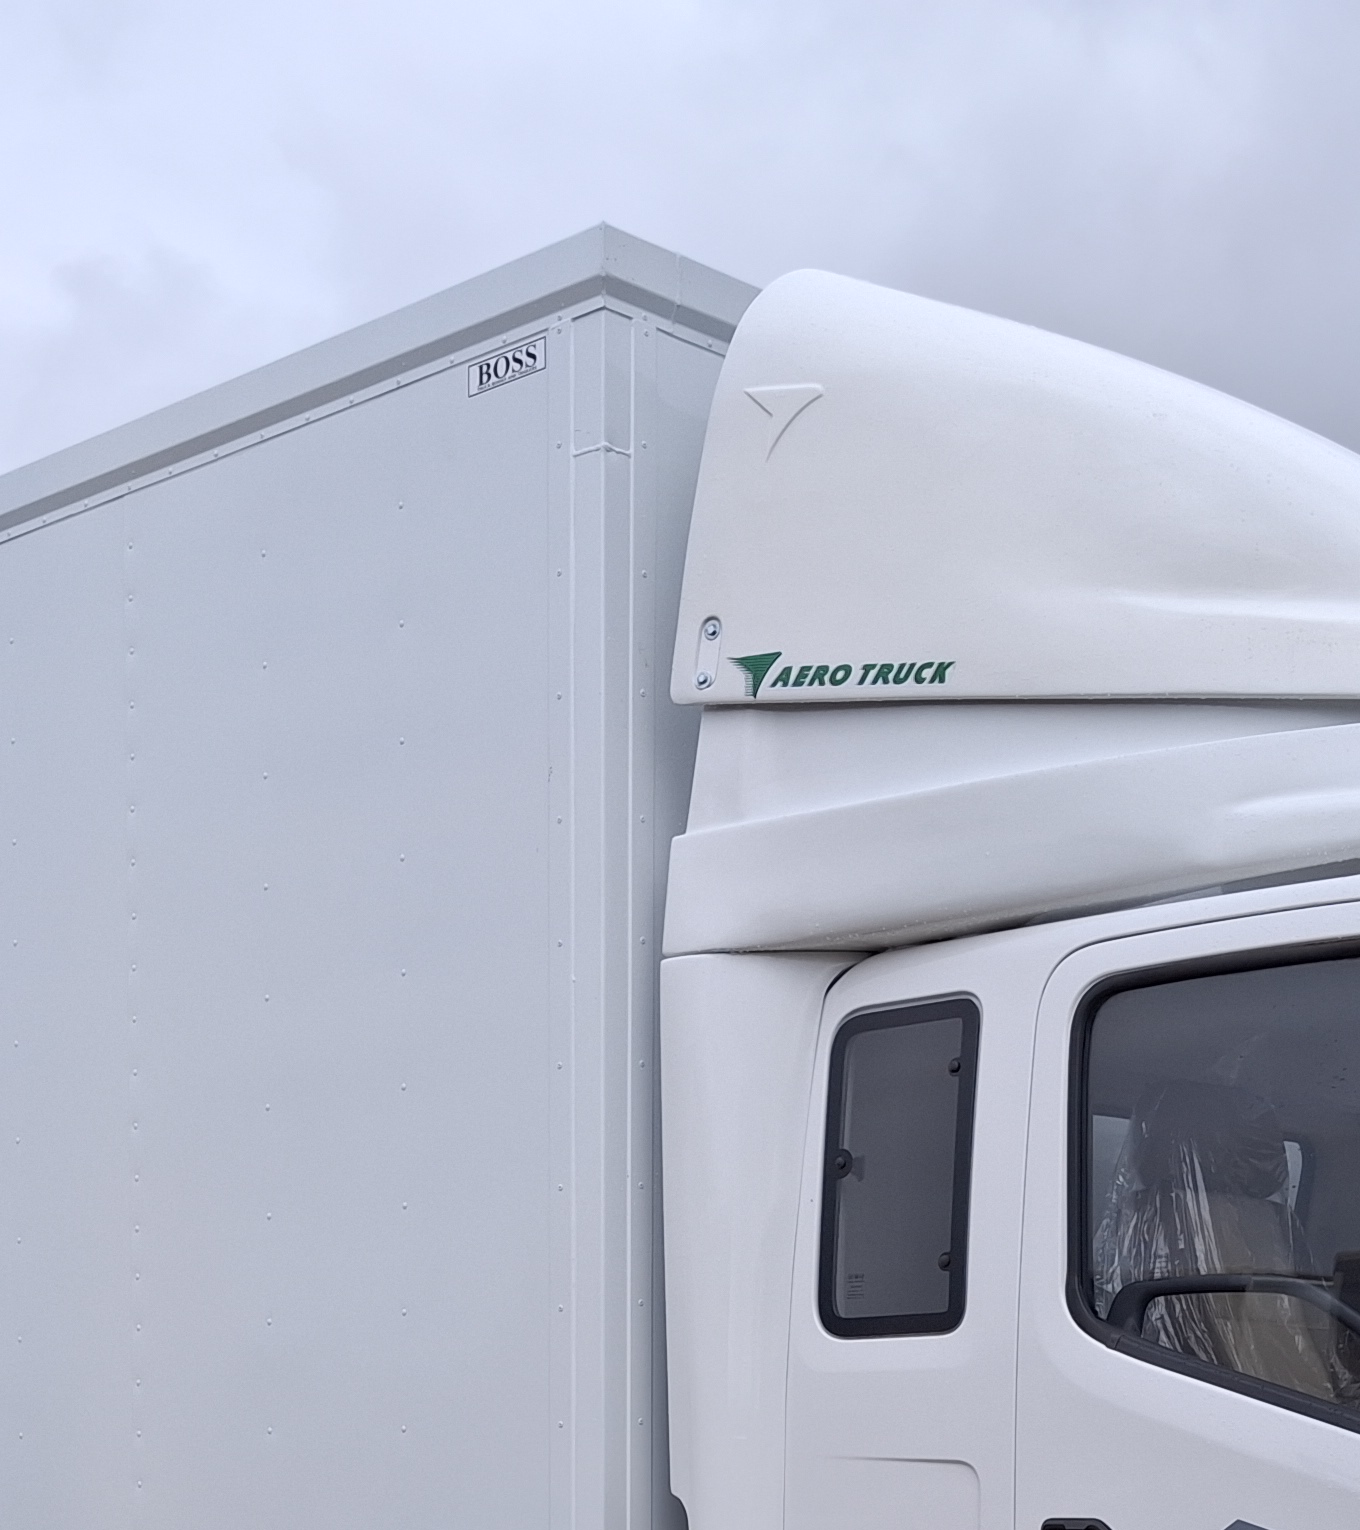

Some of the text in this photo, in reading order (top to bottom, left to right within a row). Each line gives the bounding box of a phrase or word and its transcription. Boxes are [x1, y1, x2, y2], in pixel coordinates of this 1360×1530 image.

[477, 343, 537, 387] BOSS
[768, 660, 956, 688] AERO TRUCK
